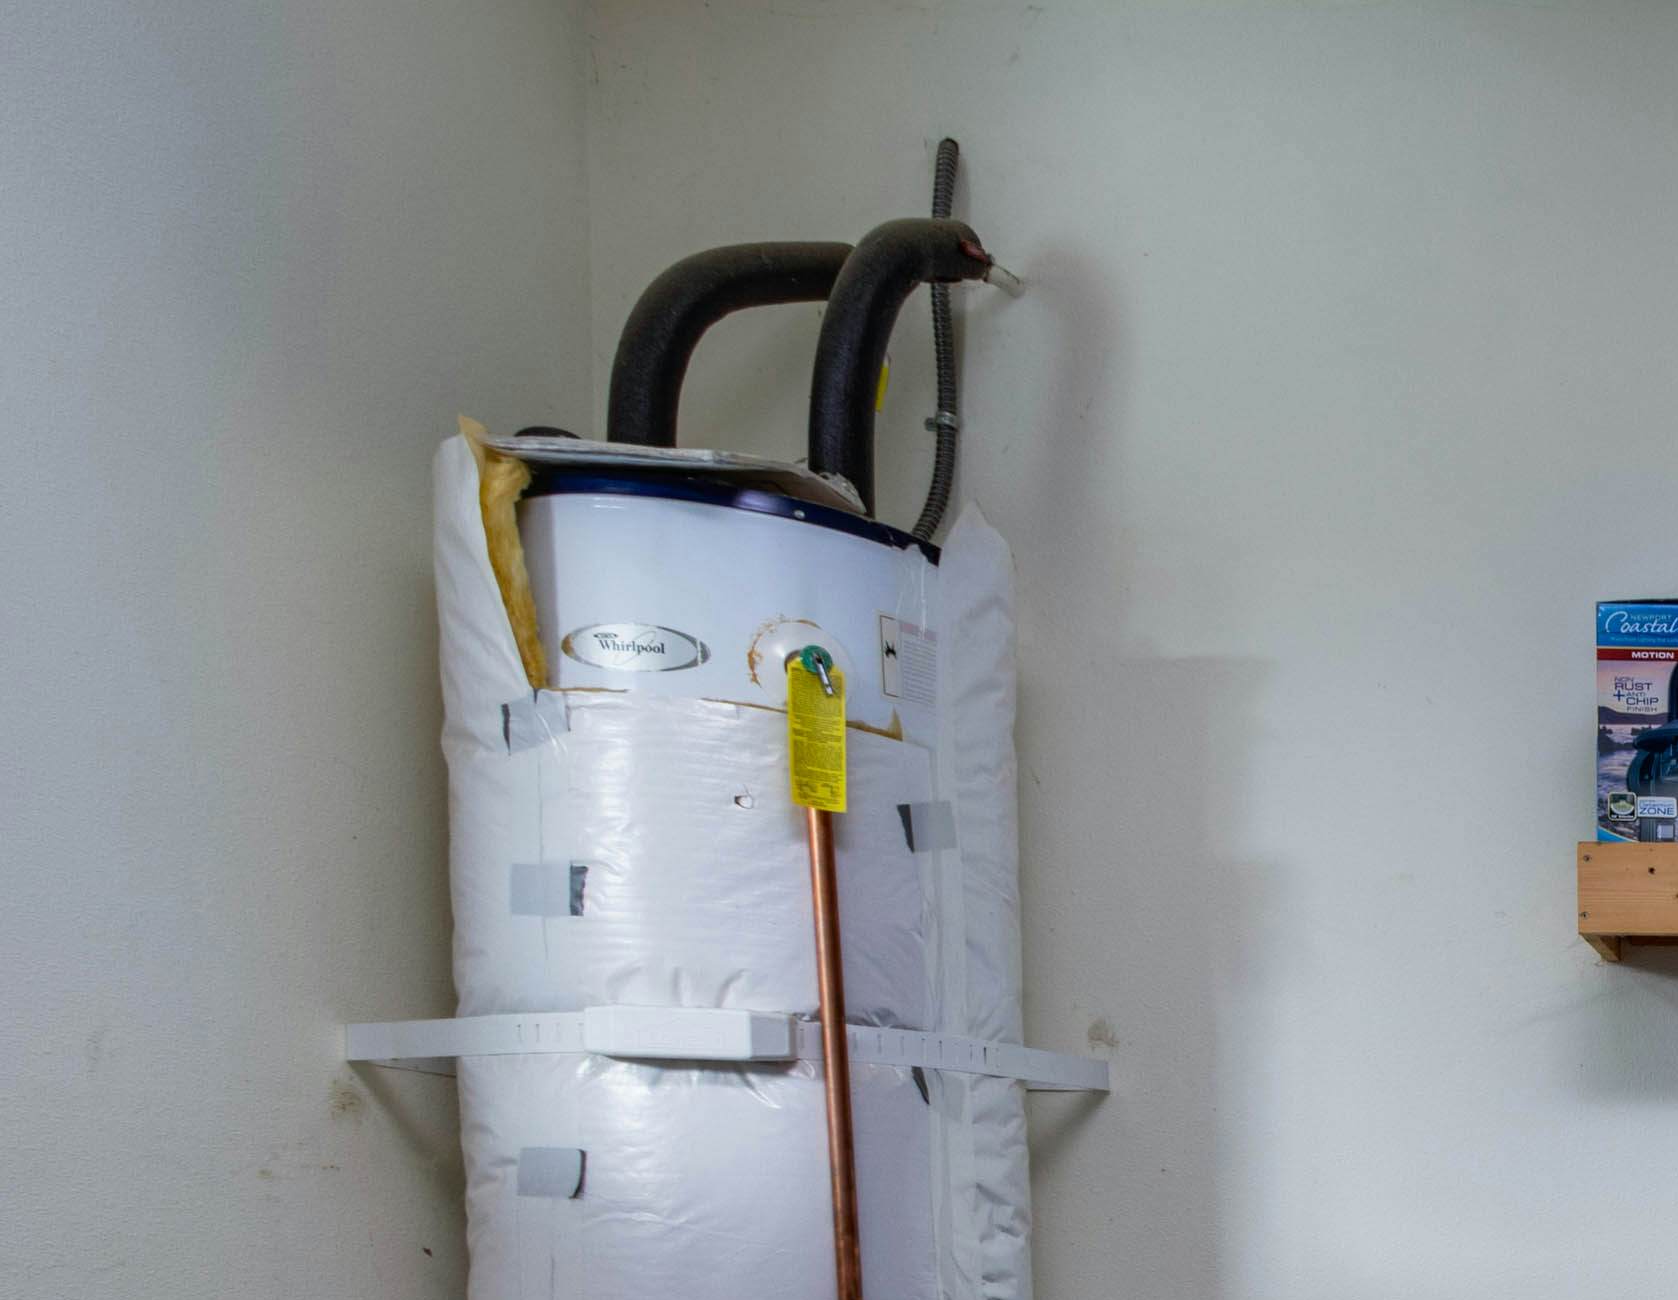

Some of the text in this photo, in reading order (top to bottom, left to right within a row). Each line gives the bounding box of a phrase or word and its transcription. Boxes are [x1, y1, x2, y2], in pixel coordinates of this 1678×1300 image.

[599, 639, 666, 656] Whirlpool
[1631, 651, 1675, 659] MOTION
[1614, 682, 1653, 691] RUST
[1626, 697, 1660, 706] CHIP
[1639, 807, 1674, 816] ZONE
